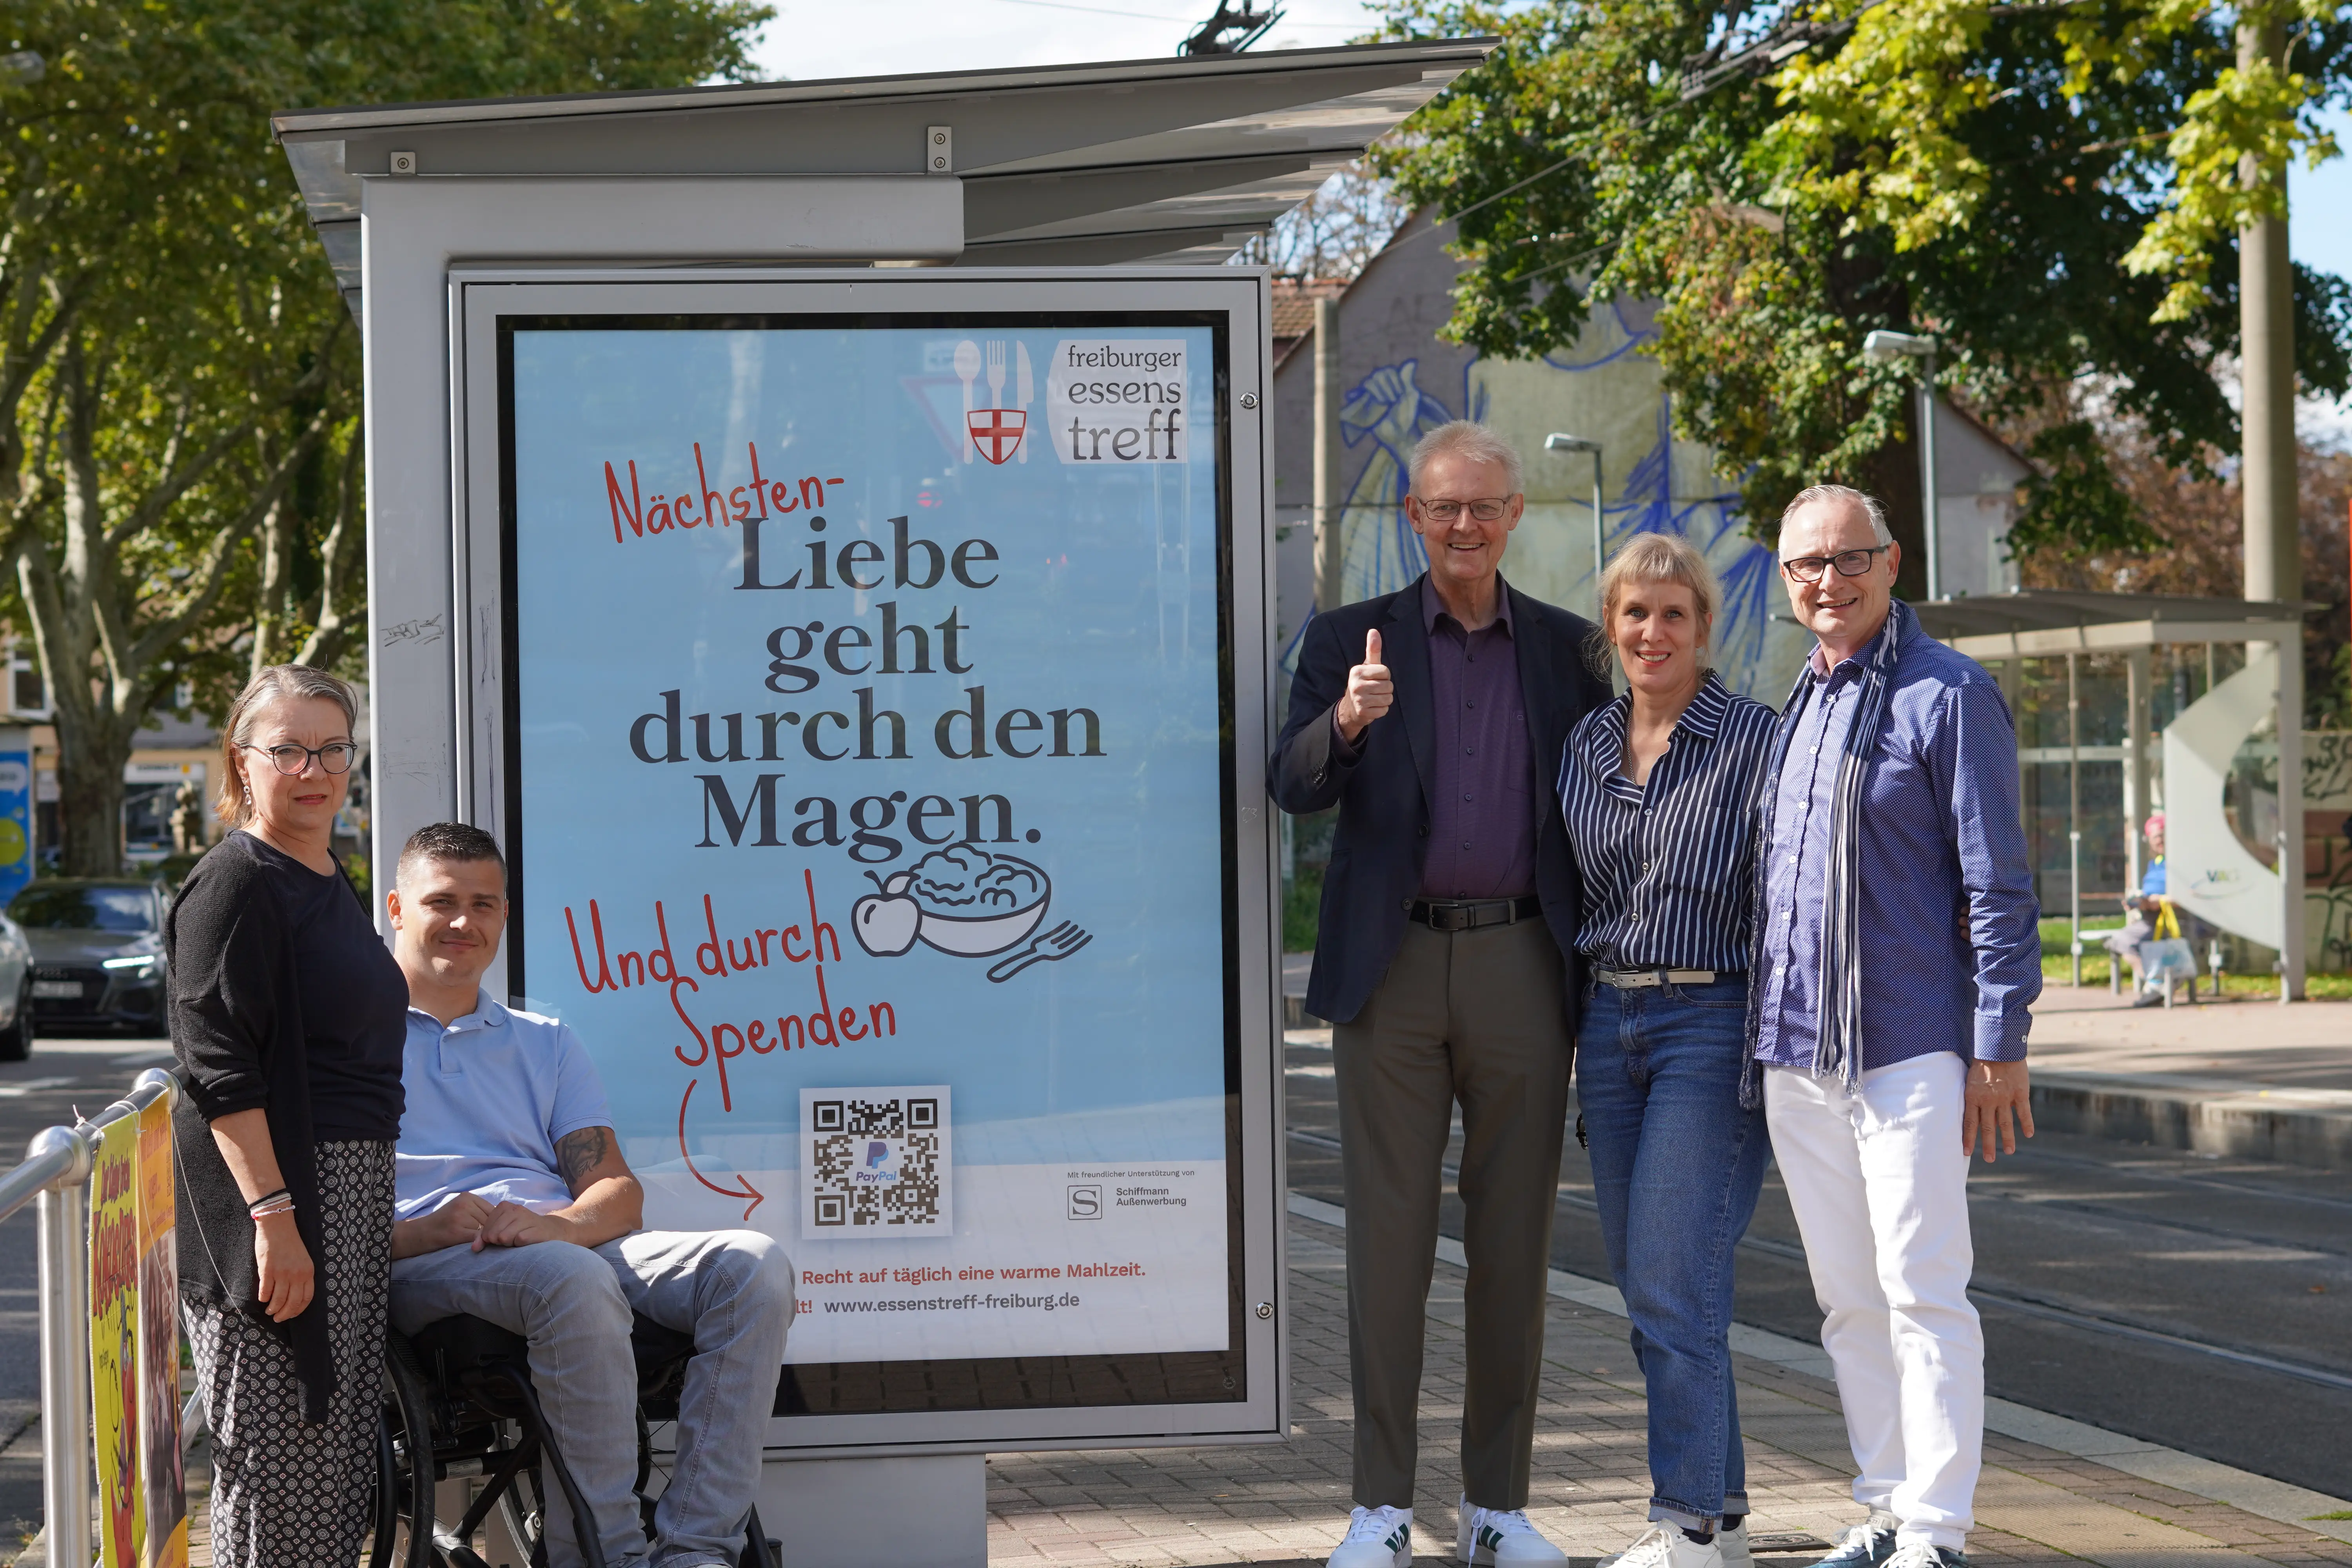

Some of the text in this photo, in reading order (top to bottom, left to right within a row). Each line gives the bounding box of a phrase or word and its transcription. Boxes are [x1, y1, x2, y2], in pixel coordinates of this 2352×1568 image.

[1068, 345, 1181, 372] freiburger
[1069, 382, 1181, 404] essens
[1068, 408, 1181, 461] treff
[604, 442, 844, 543] Nächsten-
[734, 515, 1000, 590] Liebe
[764, 601, 975, 694] geht
[629, 685, 1108, 764] durch den
[694, 774, 1042, 864] Magen.
[564, 868, 841, 993] Und durch
[670, 964, 897, 1112] Spenden
[856, 1171, 897, 1183] PayPal
[1116, 1187, 1169, 1196] Schiffmann
[1073, 1190, 1098, 1215] S
[1116, 1197, 1187, 1207] Außenwerbung
[802, 1262, 1146, 1285] Recht auf täglich eine warme Mahlzeit.
[824, 1292, 1080, 1313] www.essenstreff-freiburg.de
